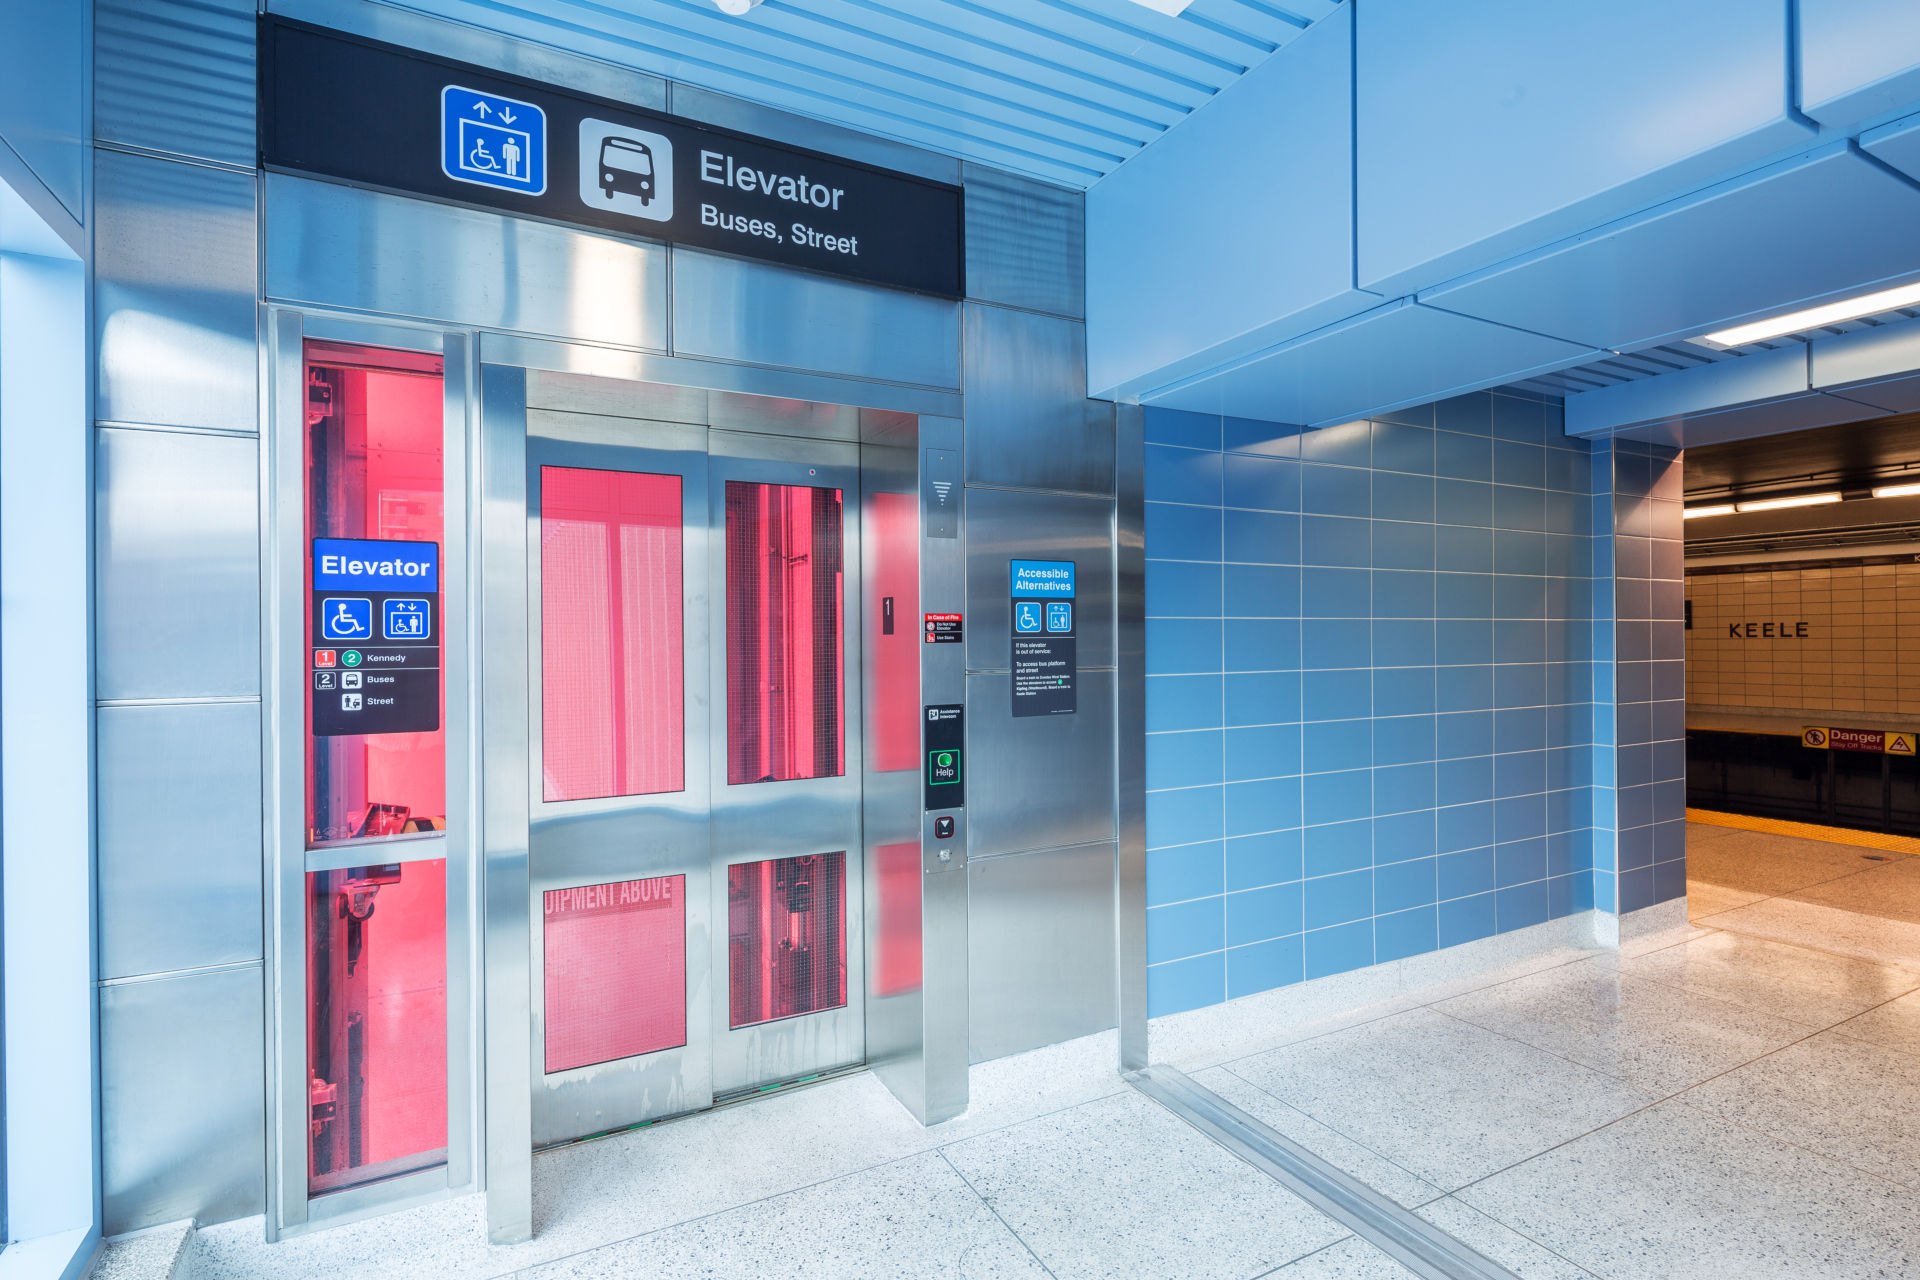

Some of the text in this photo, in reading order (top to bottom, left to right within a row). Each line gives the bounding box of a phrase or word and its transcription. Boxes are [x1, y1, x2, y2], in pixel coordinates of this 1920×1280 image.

[700, 149, 844, 211] Elevator
[701, 203, 858, 256] Buses, Street
[322, 555, 431, 577] Elevator
[1018, 567, 1069, 579] Accessible
[1015, 580, 1071, 591] Alternatives
[886, 599, 890, 616] 1
[1729, 622, 1809, 638] KEELE
[322, 652, 328, 662] 1
[348, 654, 406, 663] 2 Kennedy
[321, 674, 330, 684] 2
[1831, 730, 1882, 743] Danger
[936, 768, 954, 777] Help
[620, 877, 671, 905] ABOVE
